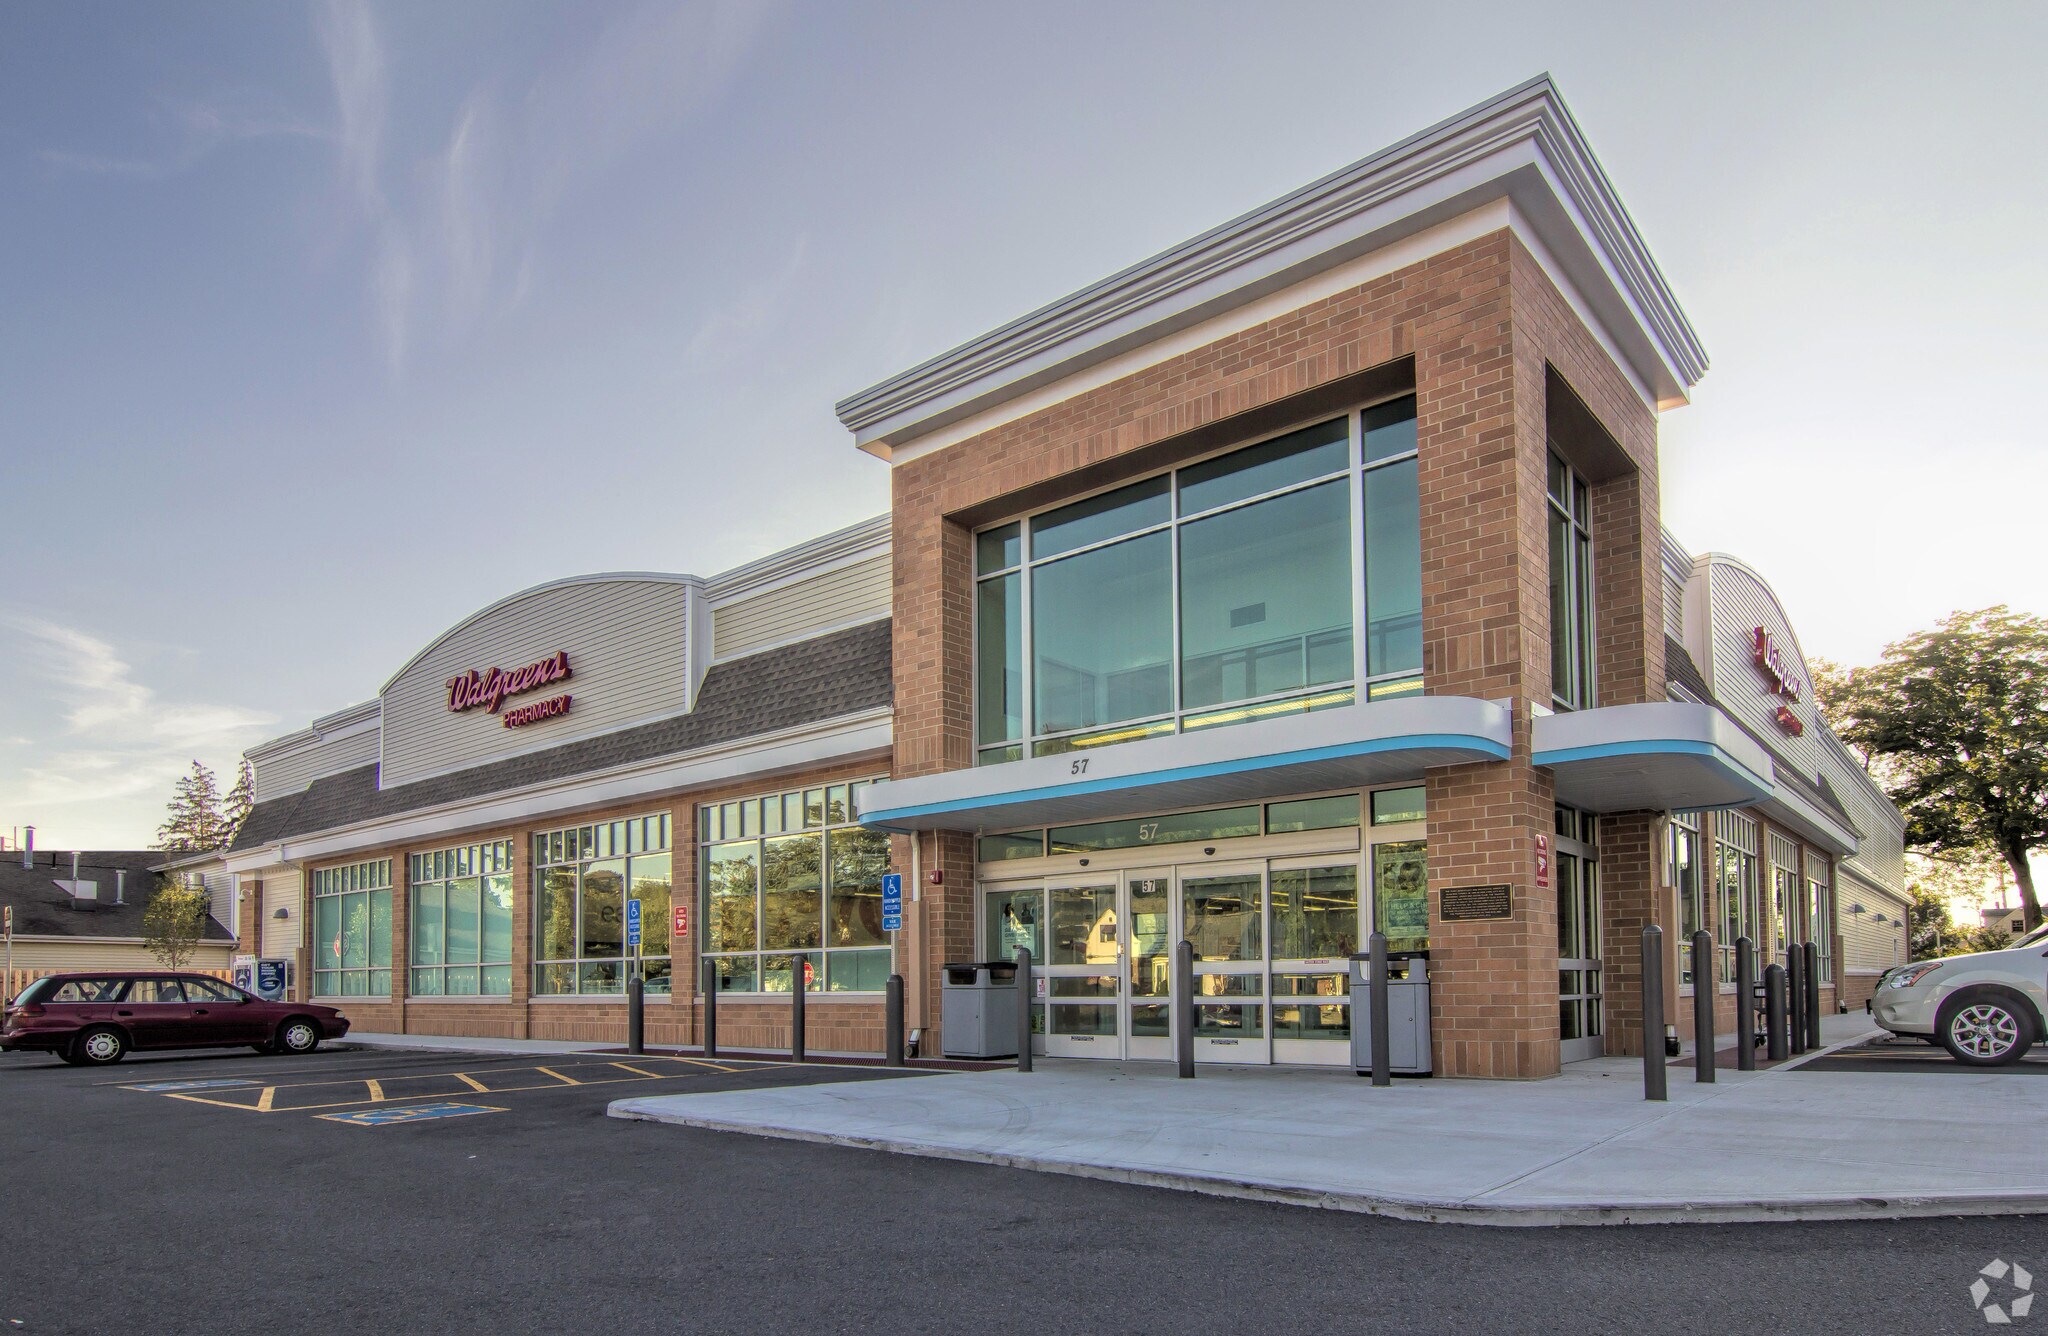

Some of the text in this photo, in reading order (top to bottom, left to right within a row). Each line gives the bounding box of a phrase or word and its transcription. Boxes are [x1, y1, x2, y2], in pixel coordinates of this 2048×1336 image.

[446, 650, 572, 714] Walgreens
[502, 695, 572, 729] PHARMACY
[1071, 758, 1089, 775] 57
[1139, 823, 1158, 840] 57
[1143, 880, 1155, 892] 57
